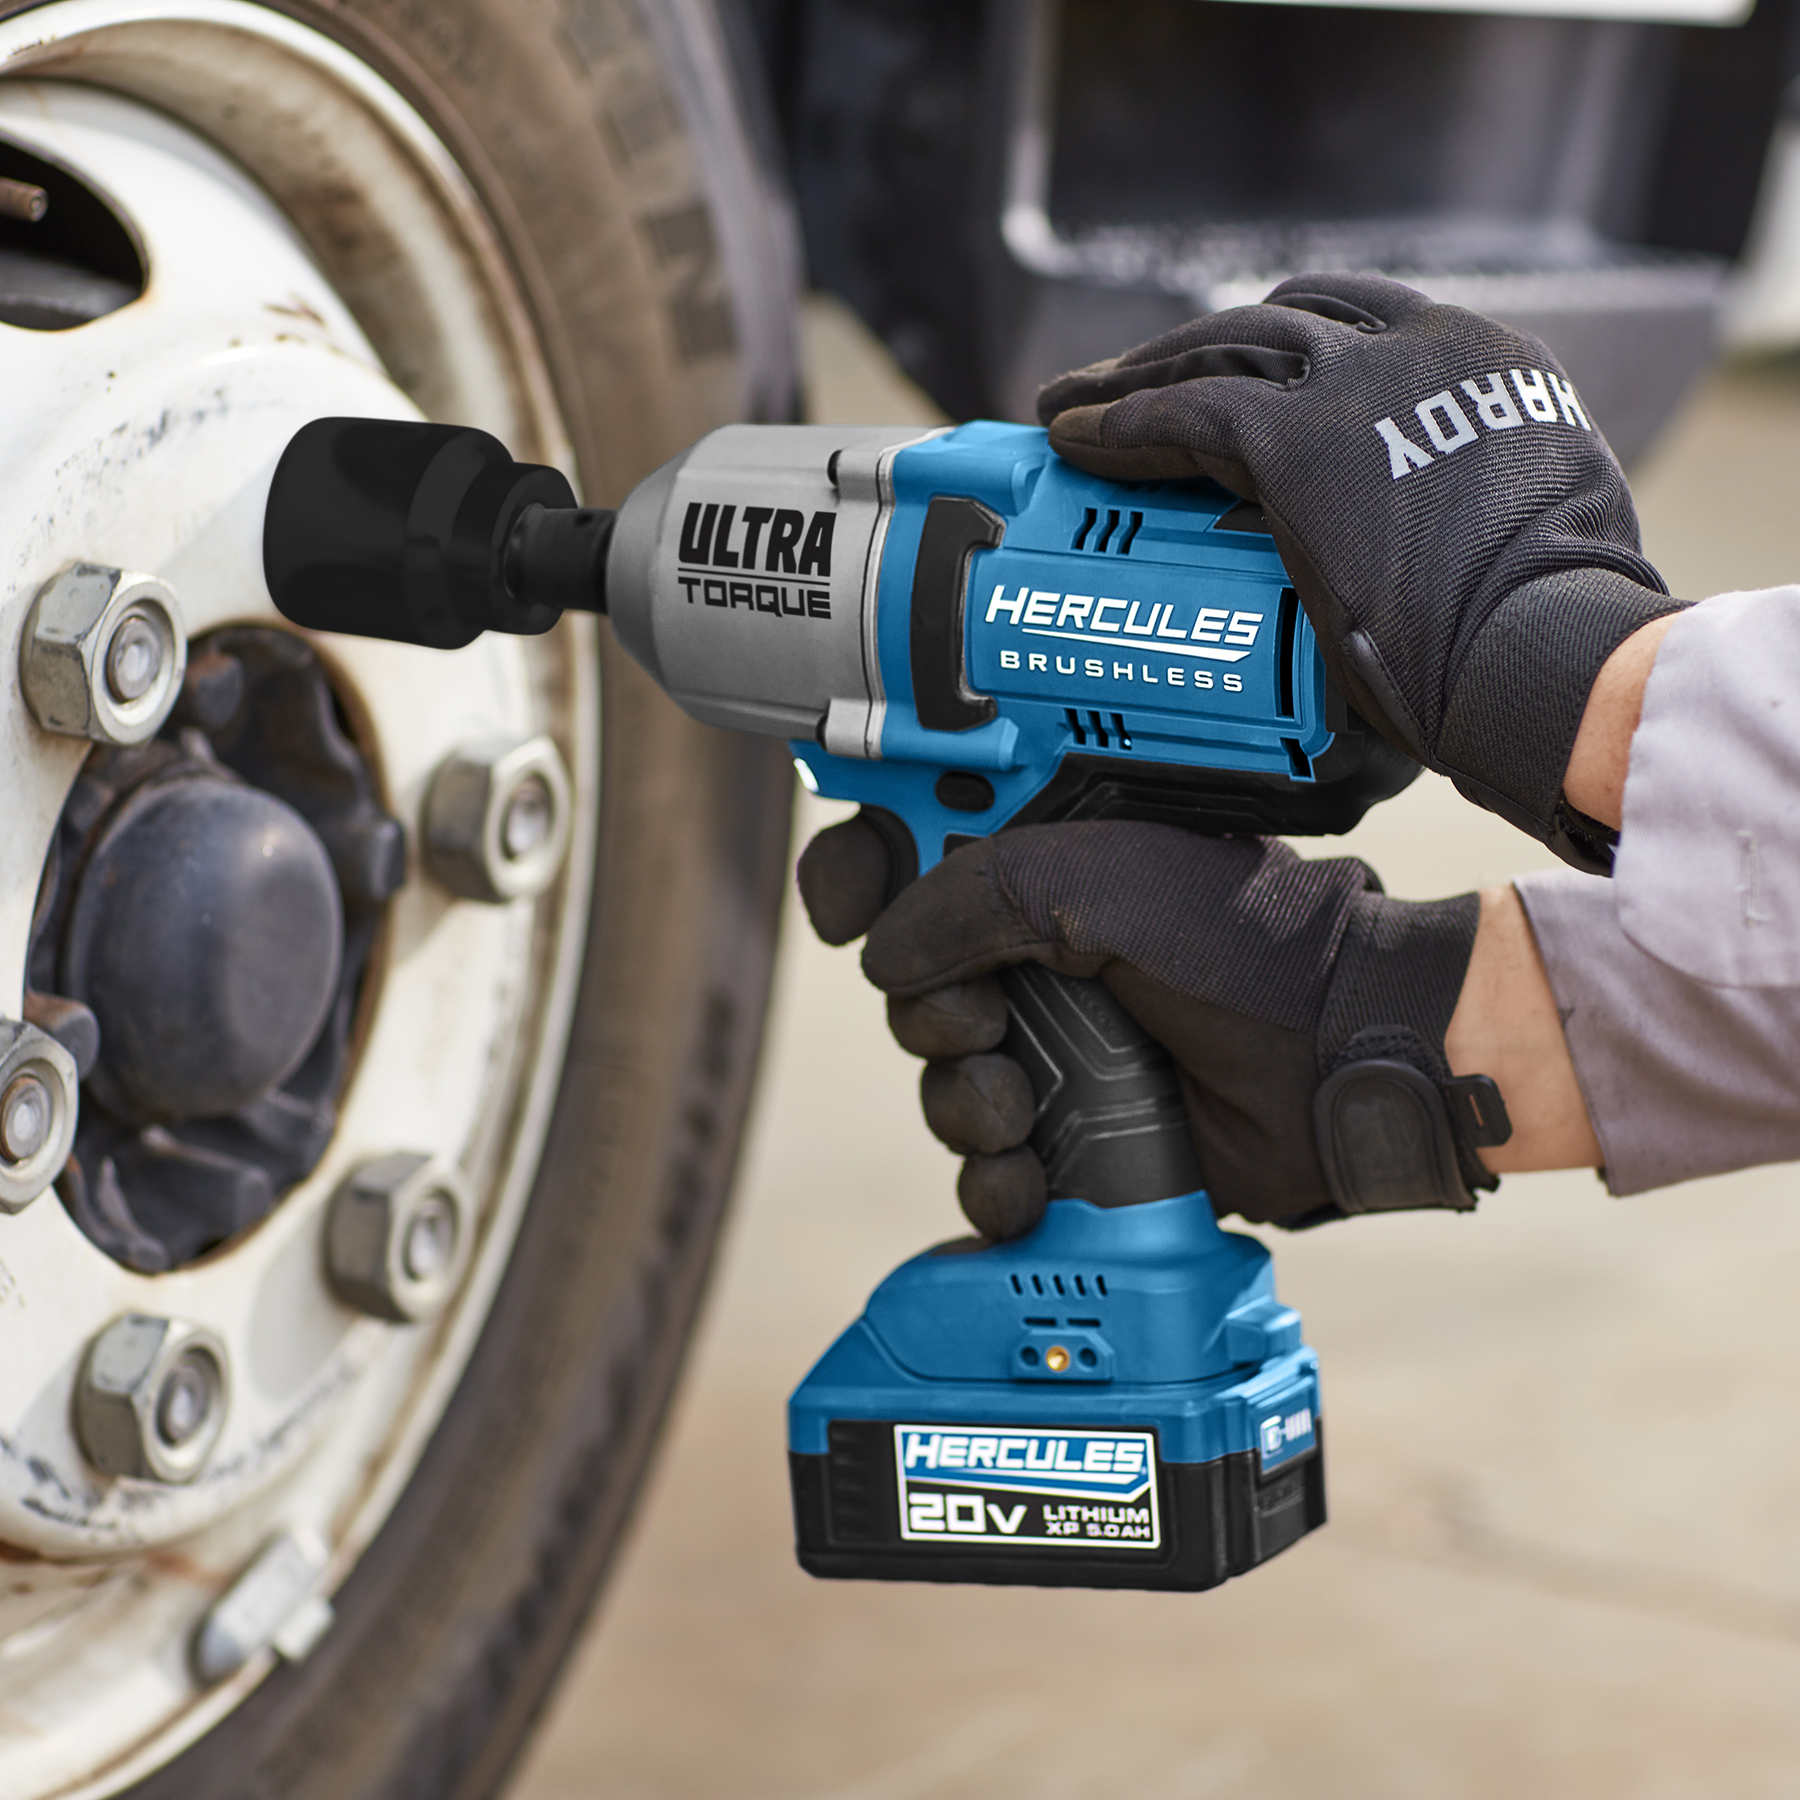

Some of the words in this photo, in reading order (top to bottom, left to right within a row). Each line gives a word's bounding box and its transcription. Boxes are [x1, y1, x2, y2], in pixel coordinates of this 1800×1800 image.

[1374, 368, 1591, 480] HARDY
[678, 501, 837, 577] ULTRA
[677, 576, 831, 619] TORQUE
[985, 585, 1263, 645] HERCULES
[1000, 650, 1243, 692] BRUSHLESS
[905, 1433, 1145, 1472] HERCULES
[1043, 1504, 1149, 1524] LITHIUM
[1045, 1521, 1080, 1535] XP
